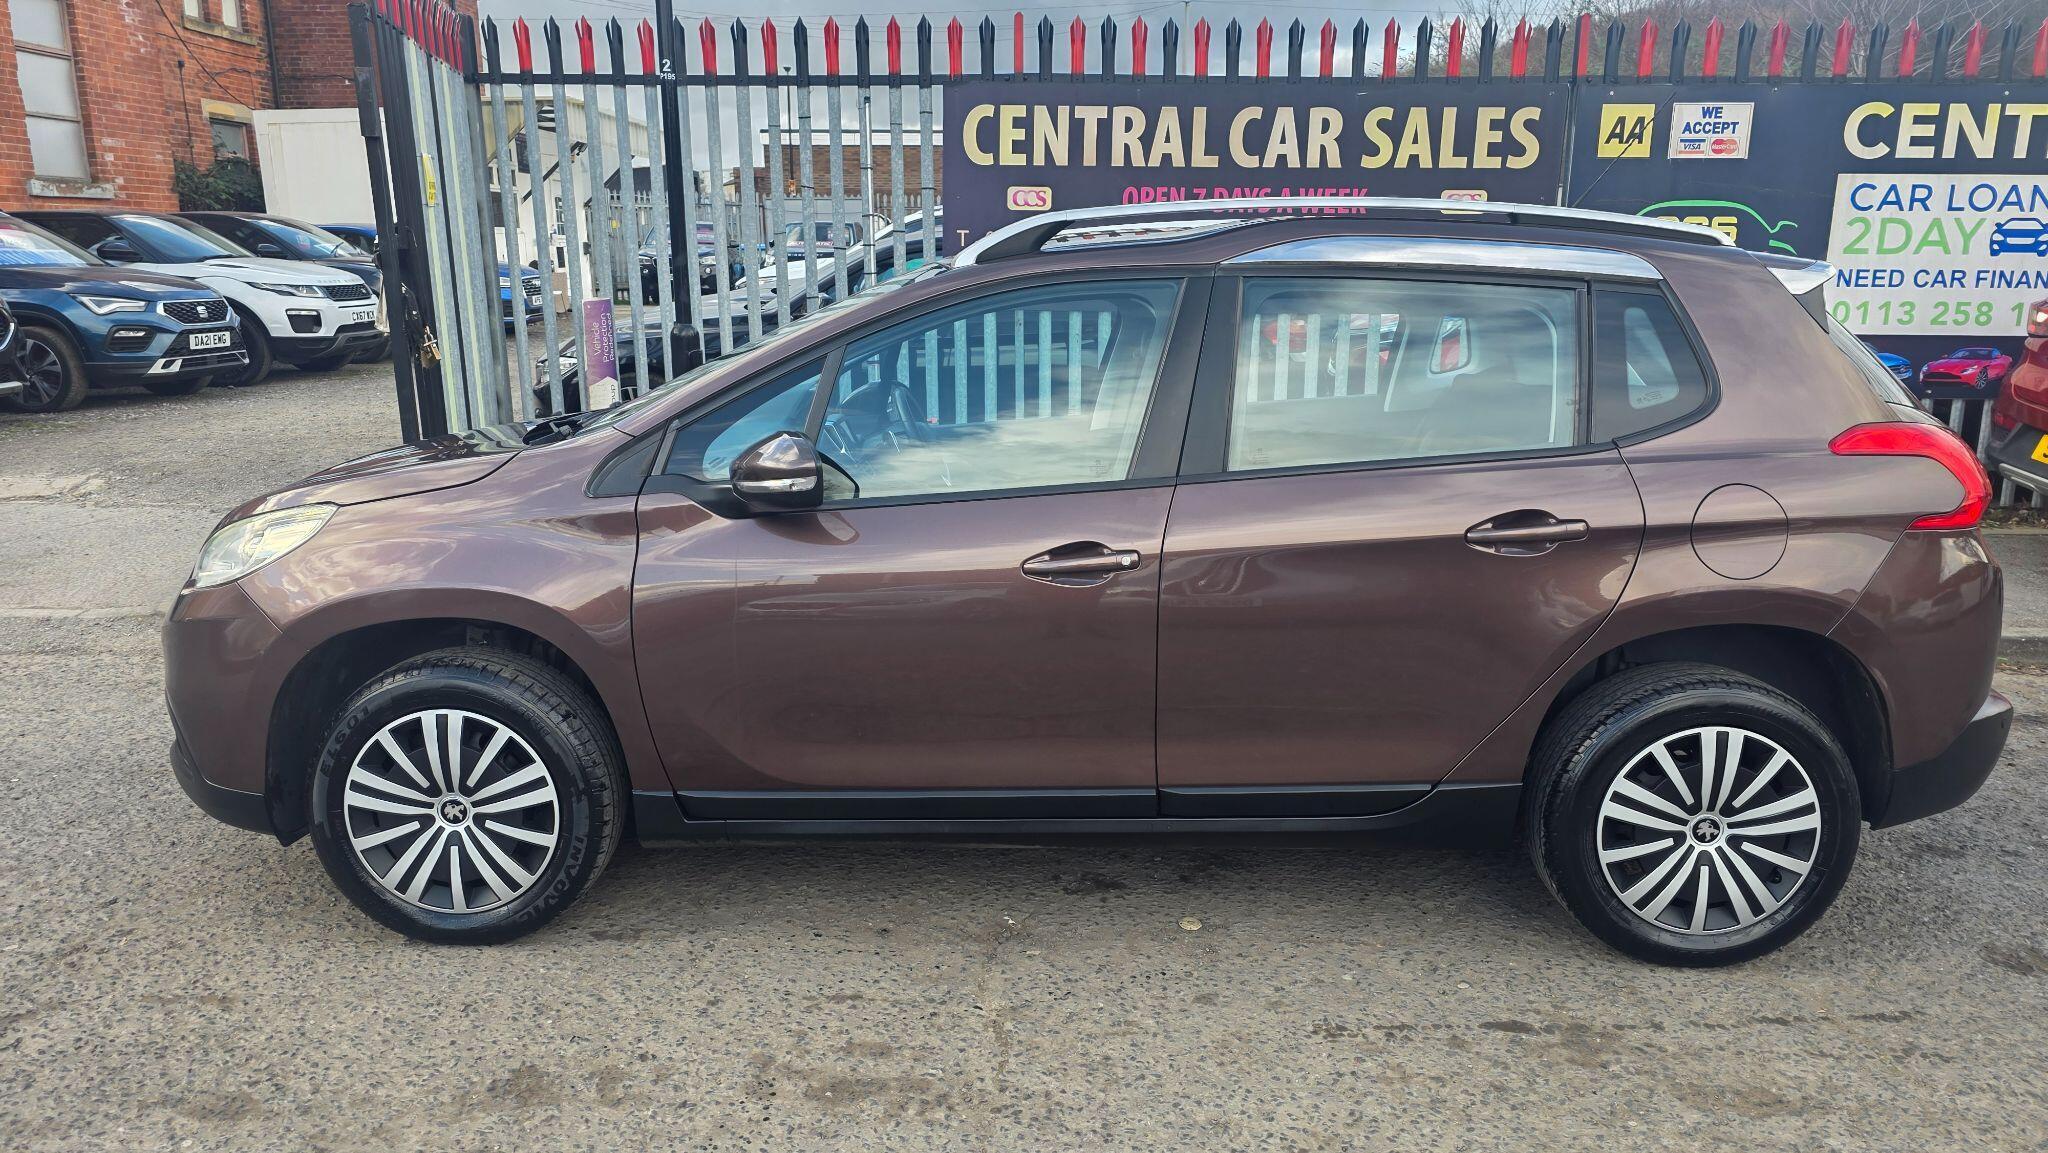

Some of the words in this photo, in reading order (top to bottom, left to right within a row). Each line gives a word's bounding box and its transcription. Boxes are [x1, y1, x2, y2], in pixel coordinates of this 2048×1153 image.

[662, 58, 671, 72] 2
[1701, 106, 1723, 119] WE
[962, 104, 1219, 168] CENTRAL
[1228, 105, 1344, 169] CAR
[1360, 106, 1543, 170] SALES
[1604, 116, 1646, 144] AA
[1682, 121, 1739, 135] ACCEPT
[1843, 101, 2048, 160] CENT
[1122, 186, 1186, 206] OPEN
[1299, 188, 1368, 214] WEEK
[1850, 182, 1934, 212] CAR
[1842, 216, 1987, 256] 2DAY
[1836, 268, 1905, 288] NEED
[1913, 269, 1967, 288] CAR
[1831, 300, 1916, 326] 0113
[1930, 301, 1994, 327] 258
[2010, 302, 2025, 327] 1
[194, 334, 212, 347] DA21
[212, 333, 227, 345] EMG
[593, 322, 601, 356] Vehicle
[601, 312, 610, 363] Protection
